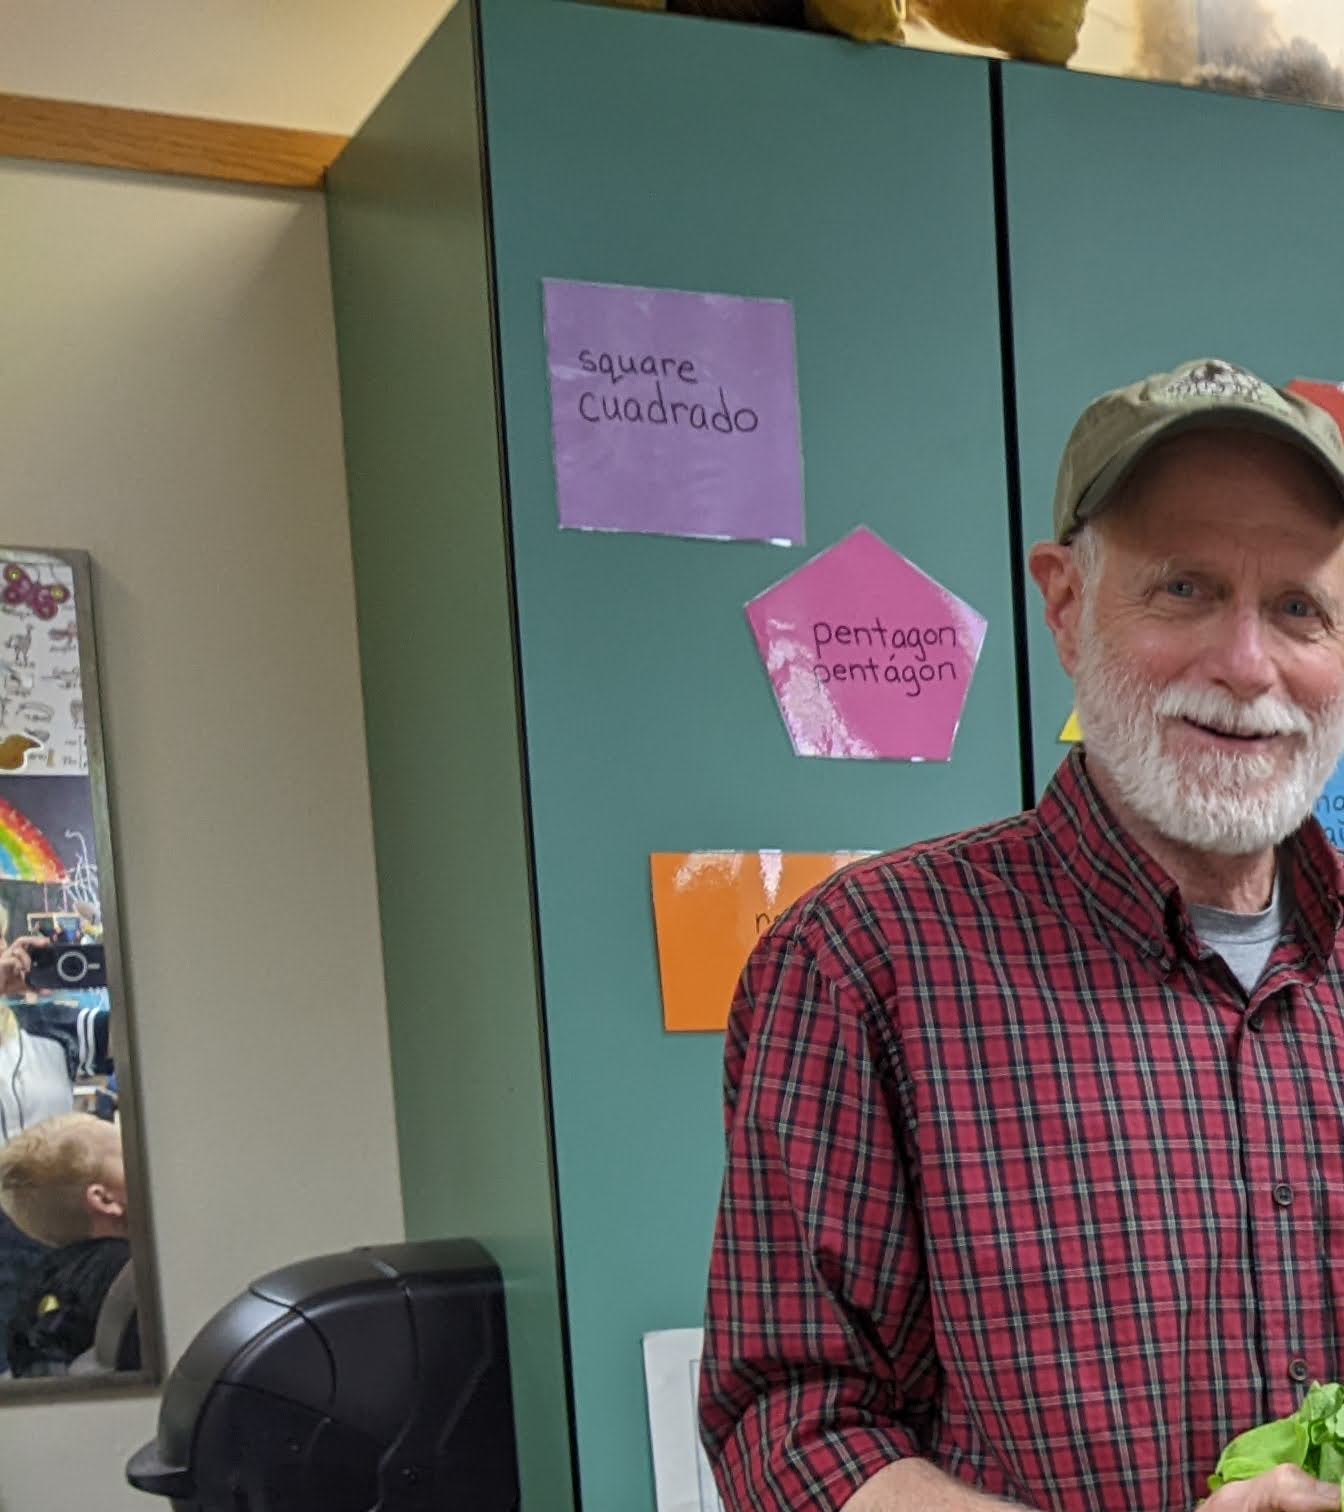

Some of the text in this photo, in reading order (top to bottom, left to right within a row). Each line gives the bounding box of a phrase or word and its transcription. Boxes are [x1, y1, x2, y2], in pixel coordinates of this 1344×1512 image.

[578, 349, 698, 384] square
[579, 380, 759, 434] cuadrado
[813, 619, 957, 659] pentagon
